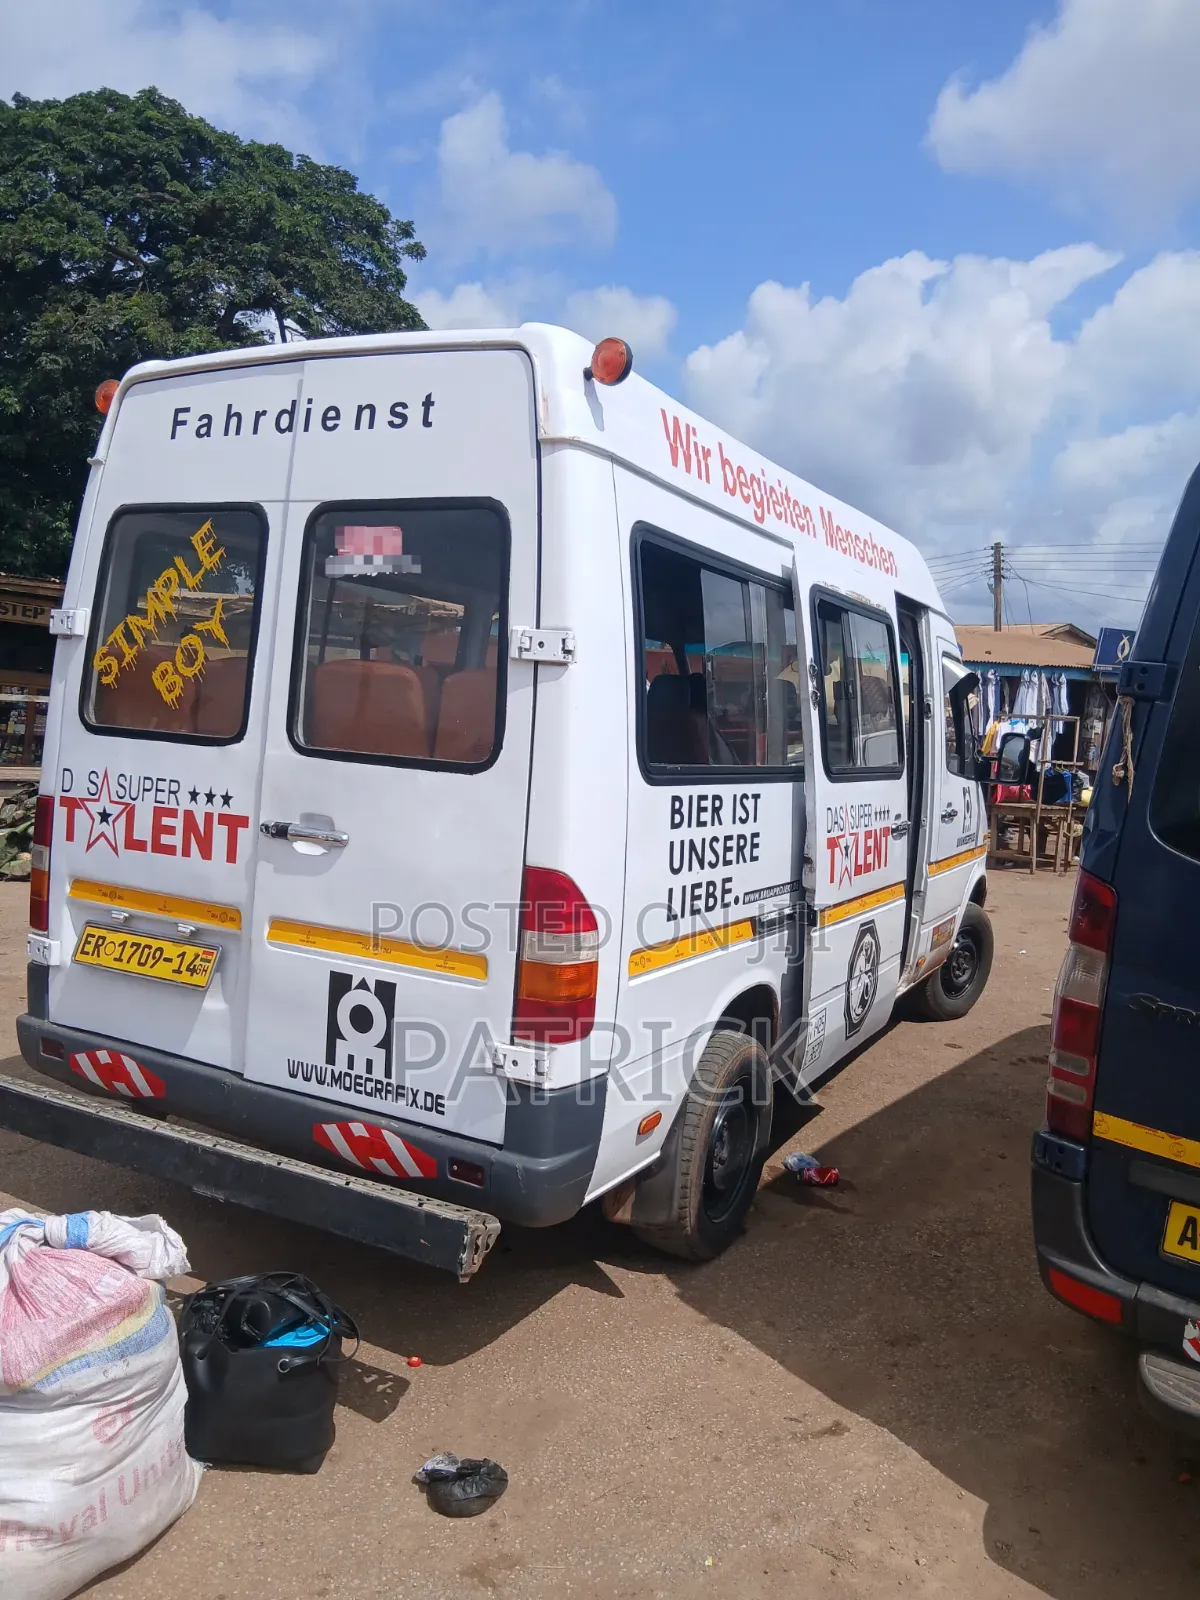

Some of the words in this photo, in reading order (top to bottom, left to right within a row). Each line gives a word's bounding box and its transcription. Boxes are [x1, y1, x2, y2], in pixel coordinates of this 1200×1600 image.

[170, 392, 435, 440] Fahrdienst
[660, 407, 711, 485] Wir
[819, 505, 898, 578] Menschen
[93, 518, 227, 689] SIMPLE
[152, 597, 231, 710] BOY
[116, 773, 181, 807] SUPER
[670, 793, 724, 830] BIER
[731, 792, 761, 825] IST
[826, 806, 845, 834] DAS
[849, 803, 873, 830] SUPER
[668, 832, 761, 876] UNSERE
[666, 876, 740, 922] LIEBE.
[79, 933, 107, 958] ER
[196, 963, 209, 977] GH
[287, 1058, 447, 1116] WWW.MOEGRAFIX.DE
[1177, 1215, 1198, 1251] A
